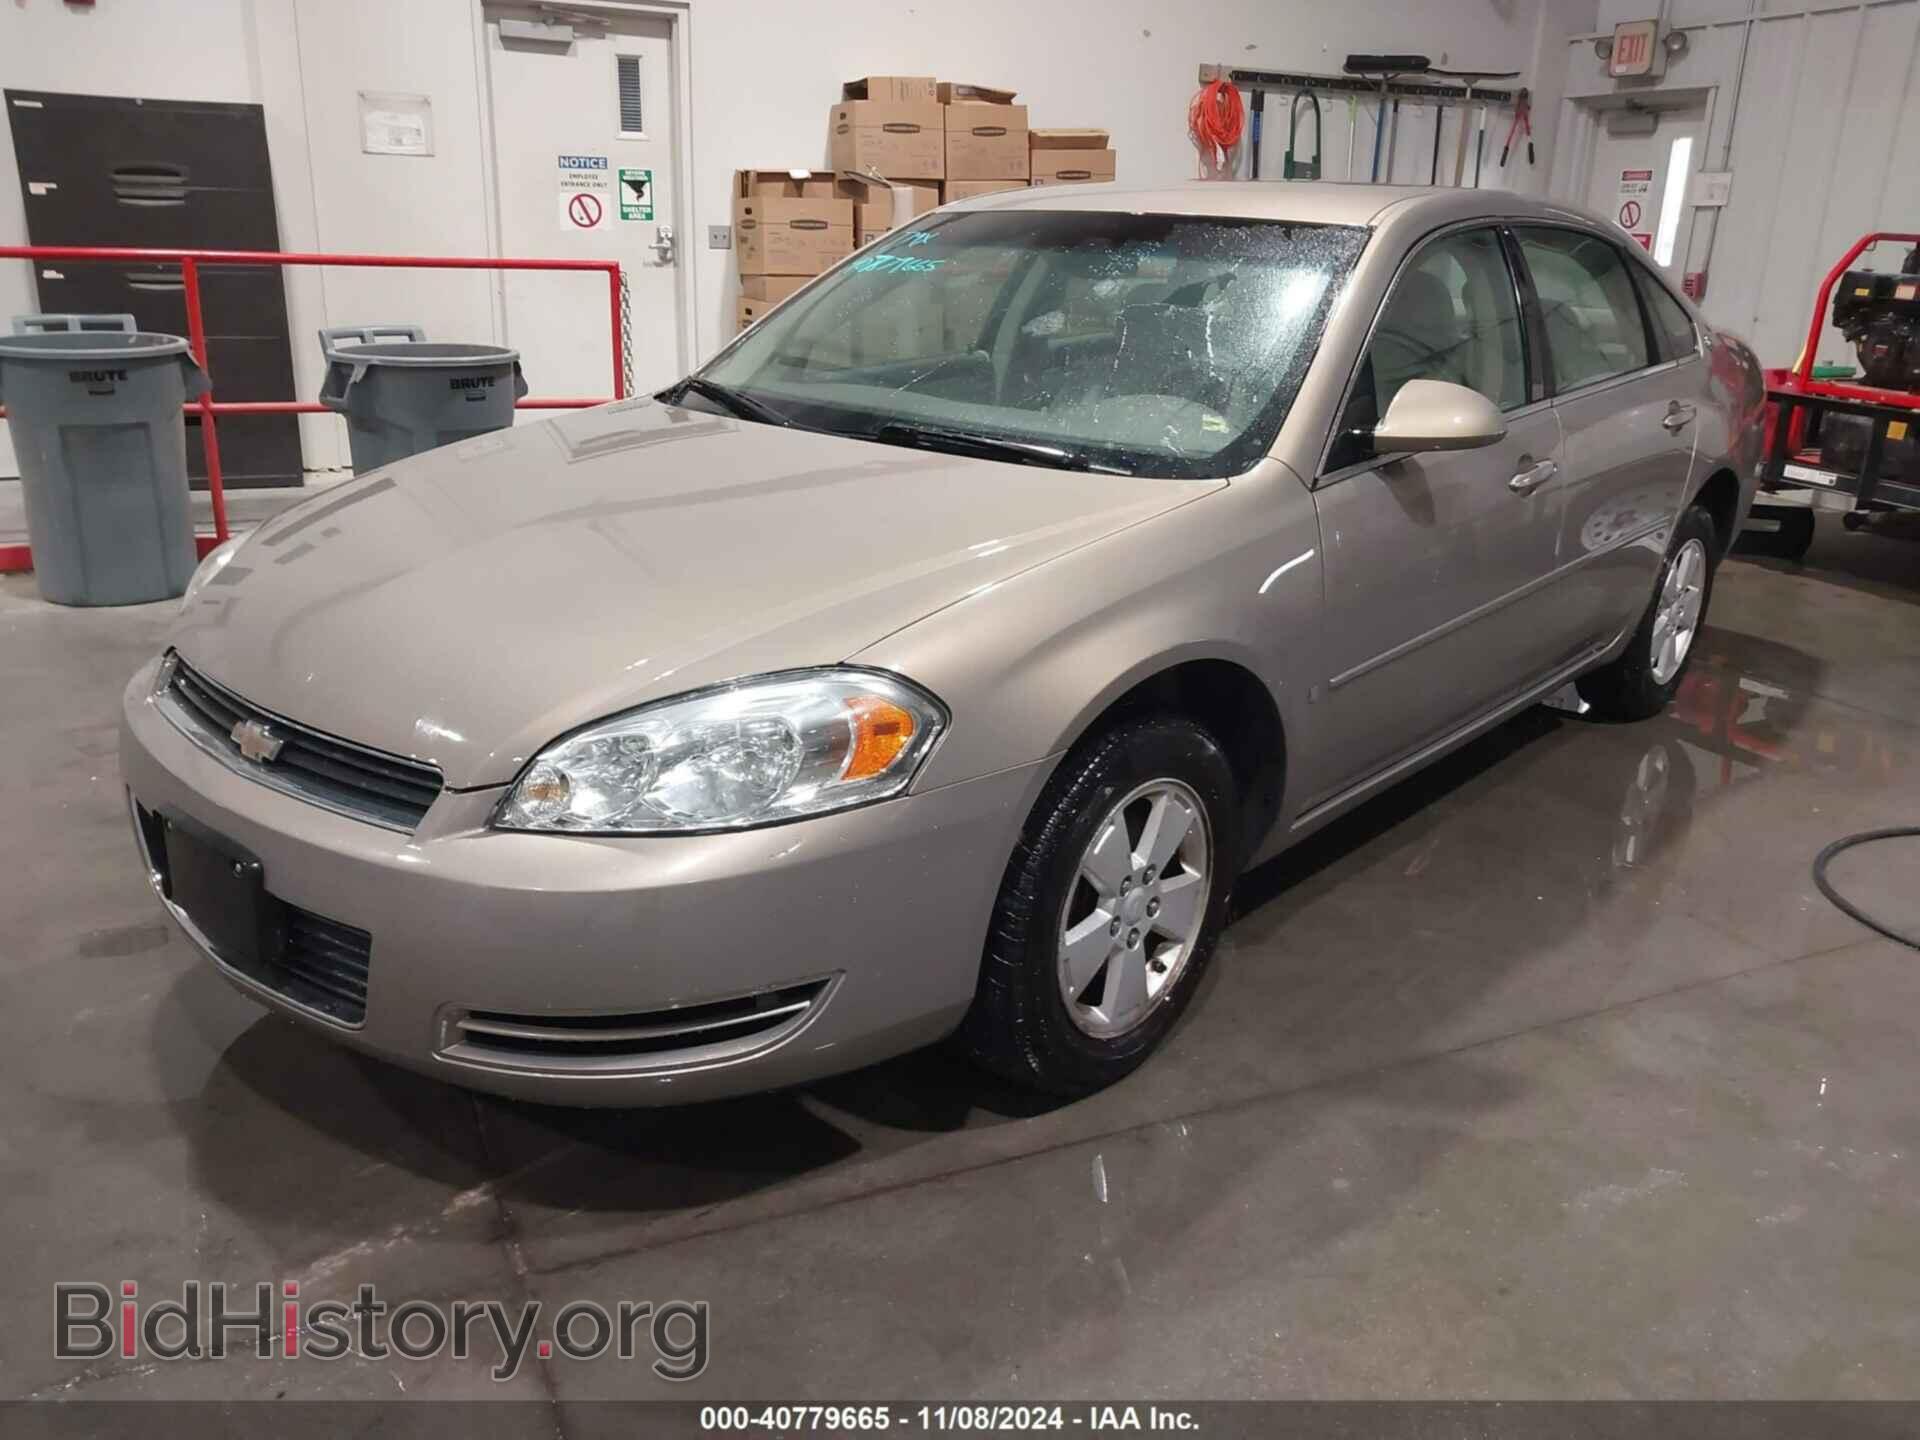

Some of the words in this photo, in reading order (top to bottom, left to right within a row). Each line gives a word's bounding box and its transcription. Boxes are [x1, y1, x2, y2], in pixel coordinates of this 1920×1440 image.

[1617, 33, 1649, 64] EXIT
[559, 157, 607, 168] NOTICE
[69, 370, 128, 382] BRUTE
[450, 376, 496, 389] BRUTE
